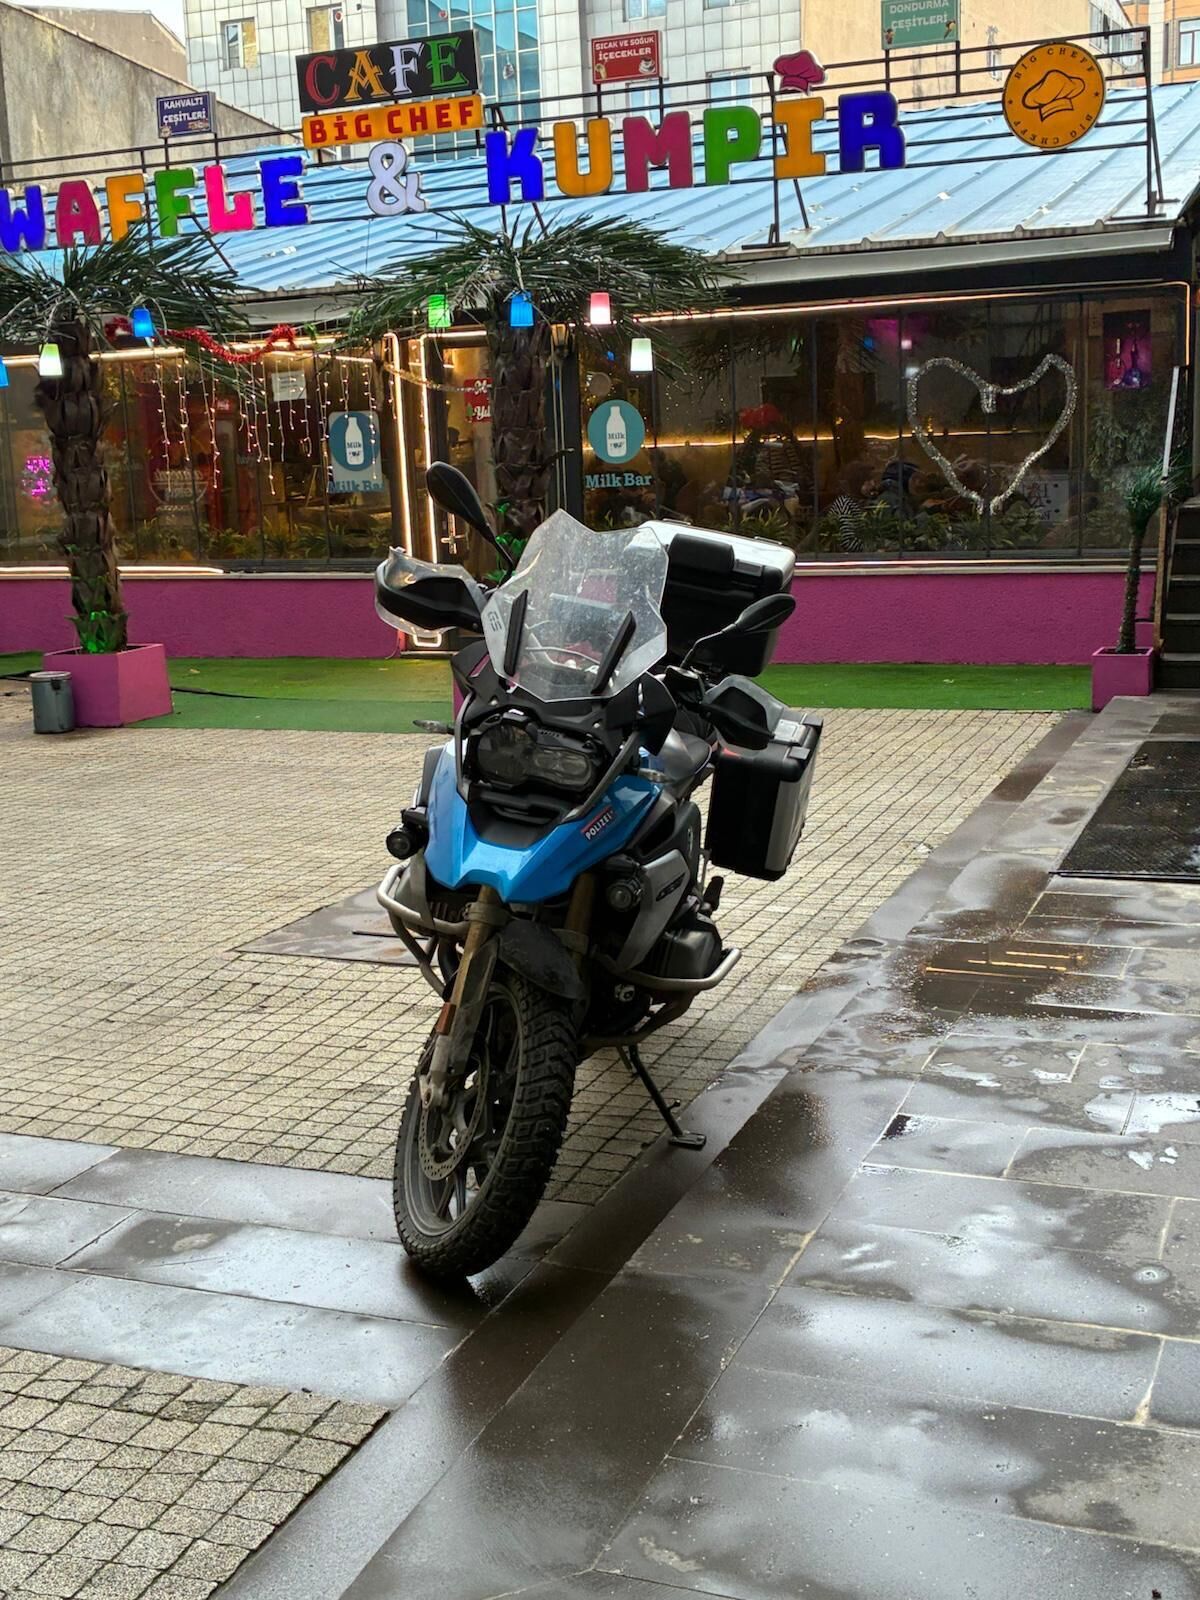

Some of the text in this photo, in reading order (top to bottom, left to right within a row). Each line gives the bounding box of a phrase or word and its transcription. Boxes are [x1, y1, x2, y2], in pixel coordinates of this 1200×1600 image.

[889, 0, 949, 14] DONDURMA
[891, 11, 948, 32] ÇEŞİTLERİ
[595, 35, 655, 51] SICAK VE SOĞUK
[598, 47, 652, 63] İÇECEKLER
[305, 36, 469, 106] CAFE
[1014, 55, 1037, 79] BIG
[163, 97, 203, 110] KAHVALTI
[162, 108, 207, 127] ÇEŞİTLERİ
[386, 100, 474, 135] CHEF
[0, 157, 309, 253] WAFFLE
[366, 141, 428, 216] &
[607, 432, 625, 440] Milk
[585, 472, 652, 489] Milk Bar
